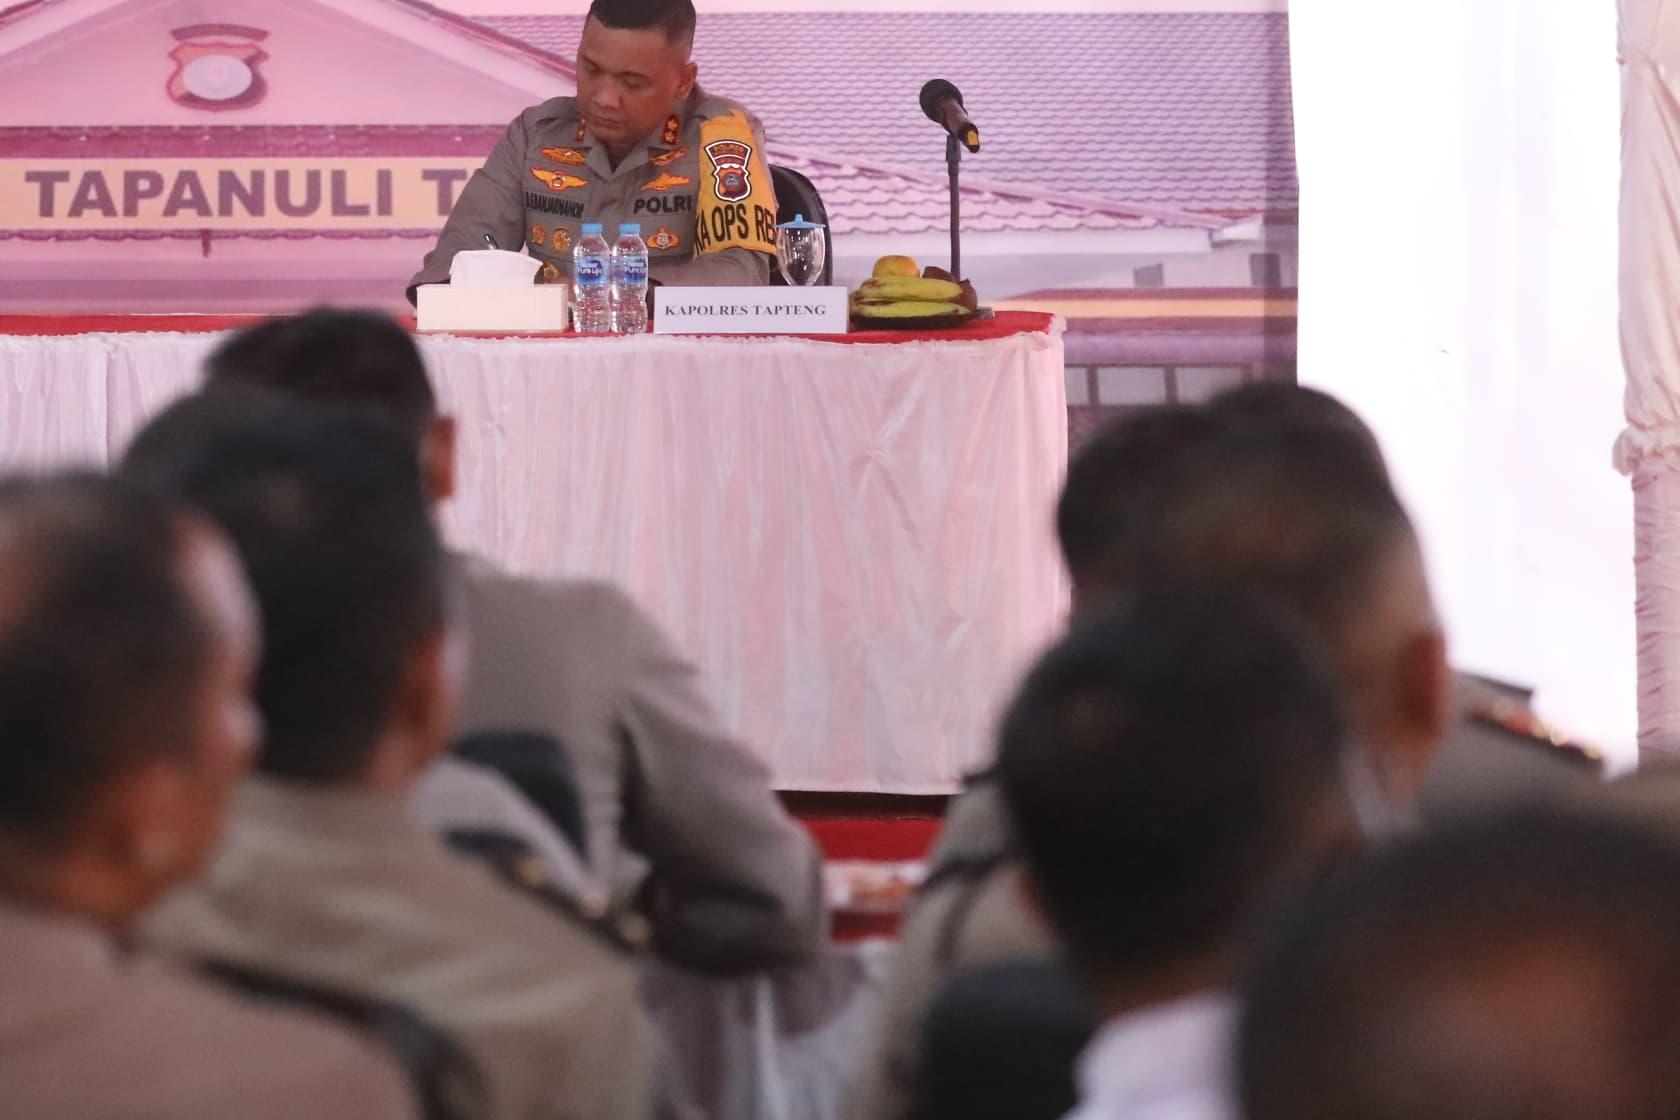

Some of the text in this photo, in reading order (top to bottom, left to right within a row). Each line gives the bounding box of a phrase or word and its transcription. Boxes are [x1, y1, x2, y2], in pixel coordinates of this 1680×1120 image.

[24, 168, 394, 218] TAPANULI
[633, 195, 694, 215] POLRI
[711, 203, 749, 243] OPS
[665, 305, 827, 316] KAPOLRES TAPTENG
